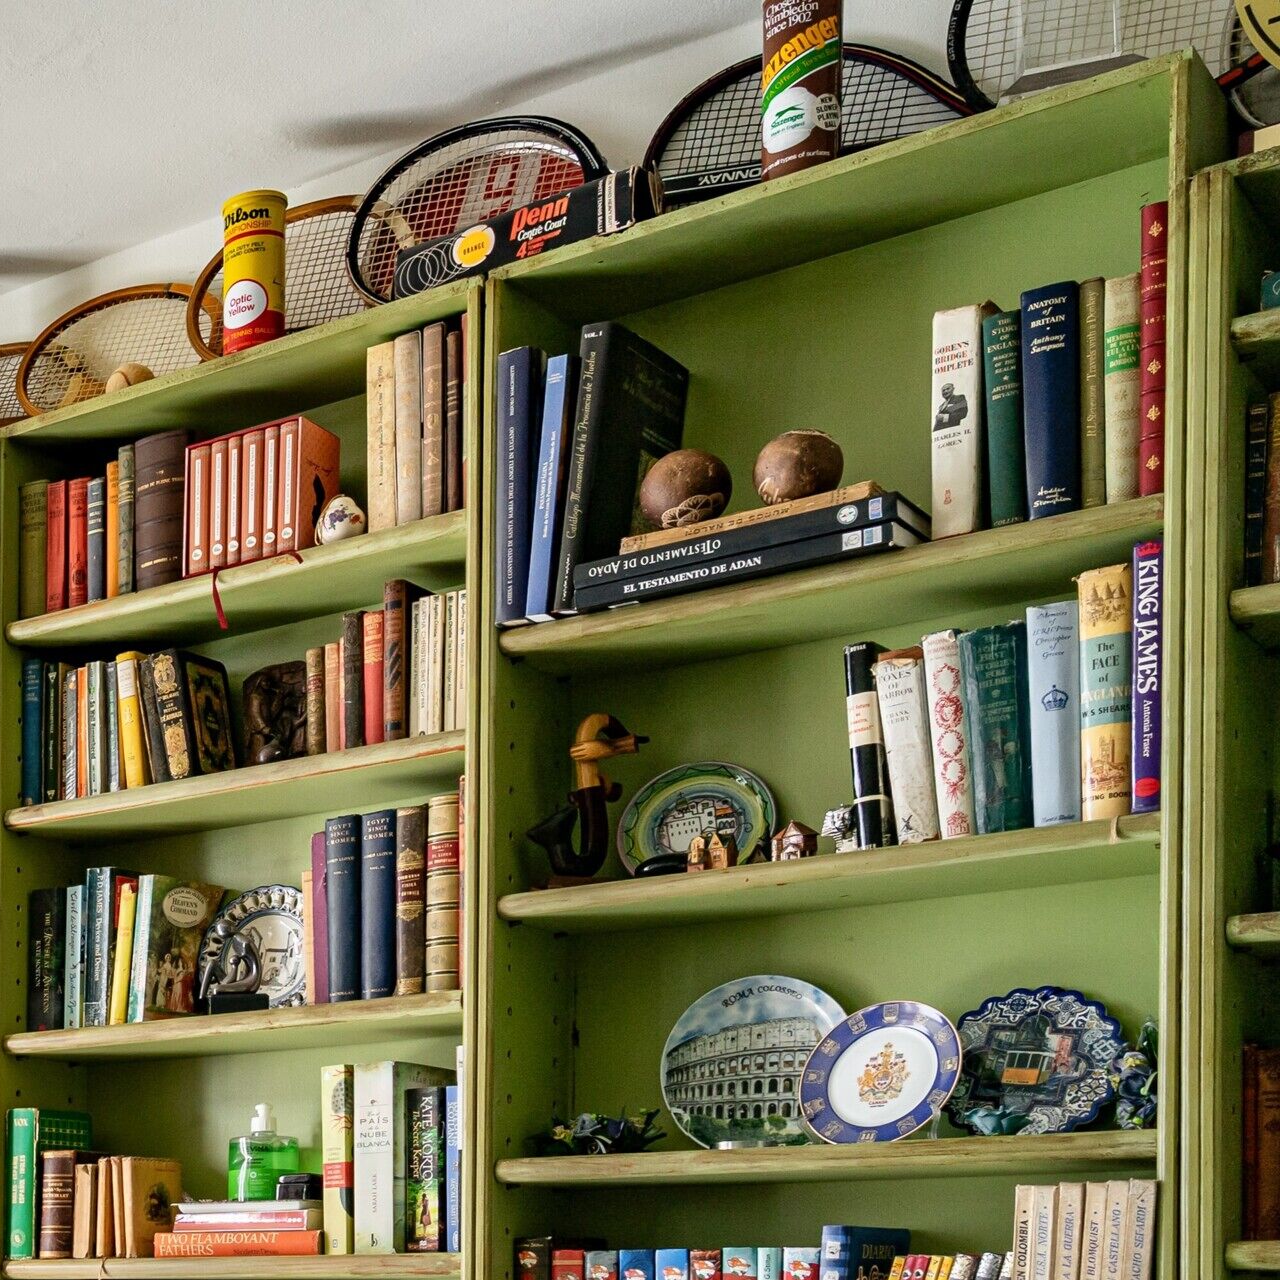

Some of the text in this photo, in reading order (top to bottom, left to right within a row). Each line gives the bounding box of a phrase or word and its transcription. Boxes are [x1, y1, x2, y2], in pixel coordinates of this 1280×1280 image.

[766, 11, 812, 40] since 1902
[544, 216, 568, 232] Court
[462, 241, 486, 256] ORANGE
[229, 293, 253, 308] Optic
[1027, 295, 1068, 312] ANATOMY
[228, 303, 255, 318] Yellow
[1042, 306, 1053, 317] of
[1030, 314, 1066, 329] BRITAIN
[1030, 332, 1067, 347] Anthony
[1030, 342, 1065, 355] Sampson
[583, 351, 597, 381] Huelva
[934, 350, 968, 366] BRIDGE
[577, 394, 592, 432] Provincia
[570, 454, 586, 501] Monumental
[588, 559, 637, 578] DE ADÃO
[623, 555, 762, 594] EL TESTAMENTO DE ADAN
[1133, 557, 1158, 694] KING JAMES
[1097, 641, 1115, 652] The
[1091, 653, 1120, 671] FACE
[1098, 671, 1109, 683] of
[1142, 699, 1154, 759] Antonia Fraser
[329, 822, 352, 831] EGYPT
[366, 817, 391, 826] EGYPT
[367, 825, 388, 833] SINCE
[326, 837, 356, 846] CROMER
[363, 831, 395, 841] CROMER
[95, 891, 103, 942] JAMES Devices
[721, 984, 803, 1008] ROMA COLOSSEO
[359, 1115, 389, 1125] PAÍS
[359, 1130, 388, 1139] NUBE
[409, 1110, 421, 1179] The Secret Keeper
[419, 1095, 434, 1191] KATE MORTON
[1038, 1211, 1048, 1247] NORTE
[1064, 1211, 1075, 1251] GUERRA
[160, 1232, 280, 1245] TWO FLAMBOYANT
[1017, 1220, 1029, 1267] COLOMBIA
[160, 1244, 214, 1257] FATHERS
[1085, 1220, 1100, 1277] BLOMQUIST
